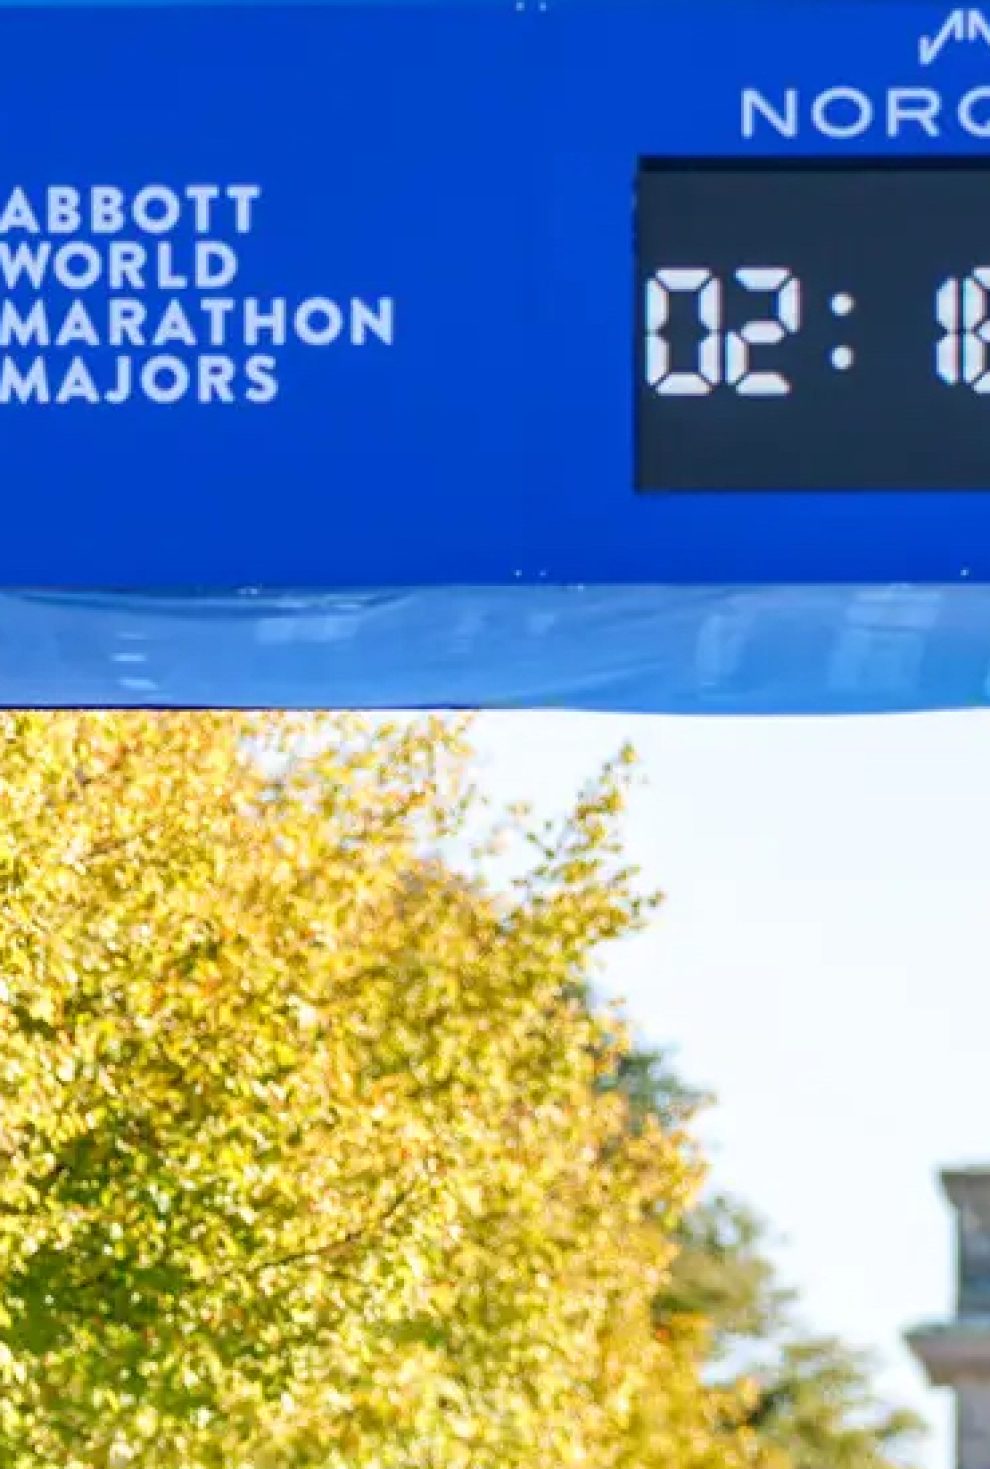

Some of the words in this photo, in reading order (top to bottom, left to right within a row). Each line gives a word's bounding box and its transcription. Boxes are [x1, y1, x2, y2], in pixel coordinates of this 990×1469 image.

[0, 186, 260, 234] ABBOTT
[0, 240, 237, 290] WORLD
[0, 296, 393, 347] MARATHON
[0, 355, 278, 404] MAJORS
